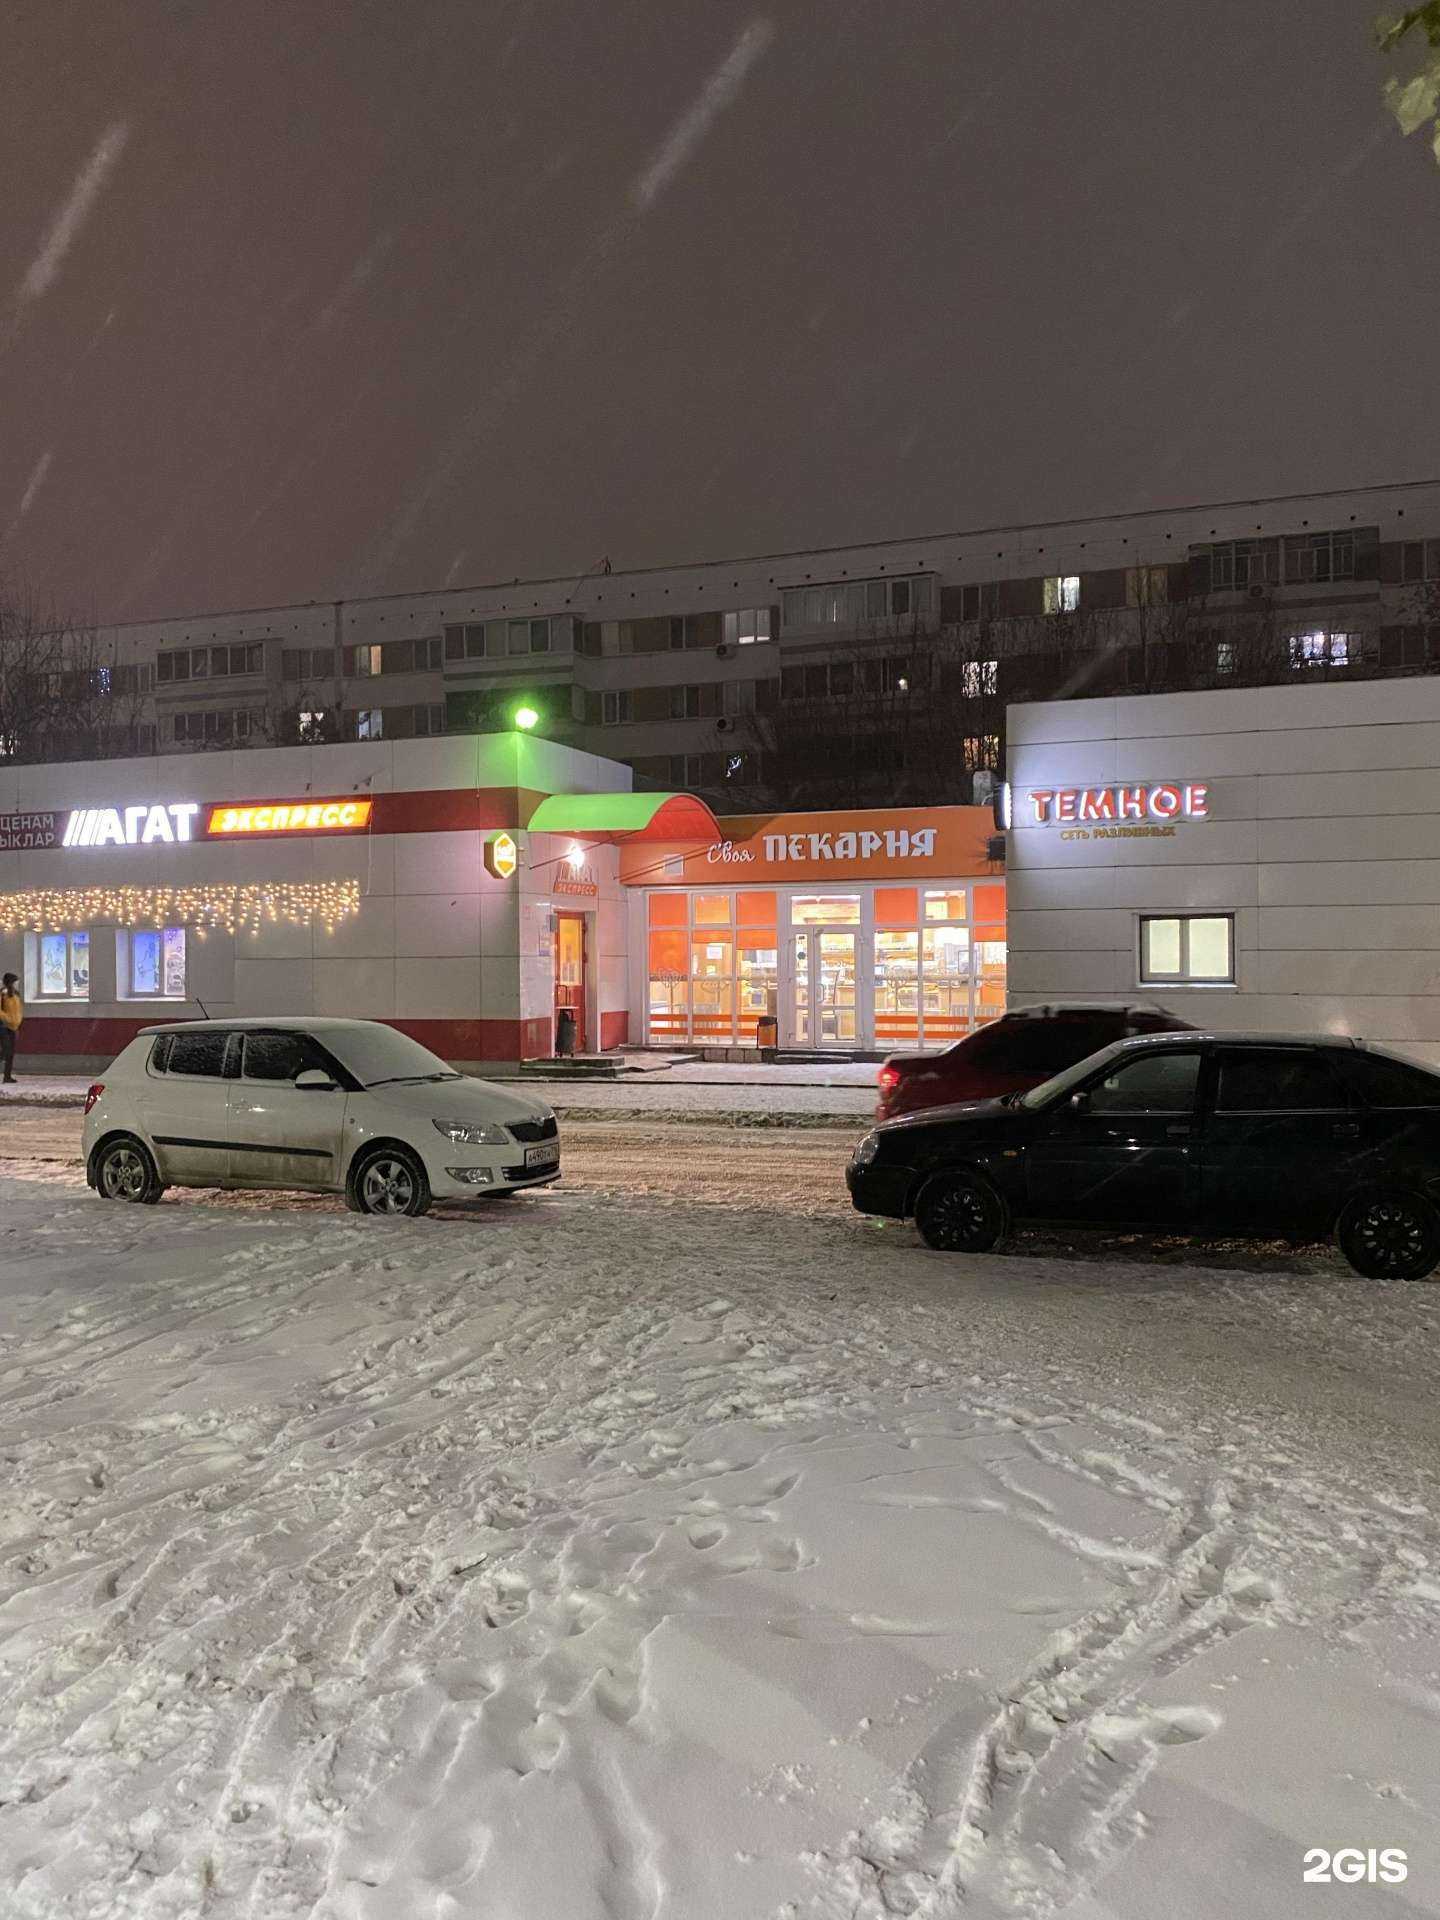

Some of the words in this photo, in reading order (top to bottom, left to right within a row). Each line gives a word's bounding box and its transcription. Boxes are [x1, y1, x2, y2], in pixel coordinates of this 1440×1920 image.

[1025, 783, 1208, 821] ТЕМНОЕ
[0, 814, 54, 833] ЦЕНАМ
[92, 803, 198, 845] АГАТ
[222, 804, 357, 831] ЭКСПРЕСС
[763, 828, 937, 862] ПЕКАРНЯ
[1060, 828, 1090, 841] СЕТЬ
